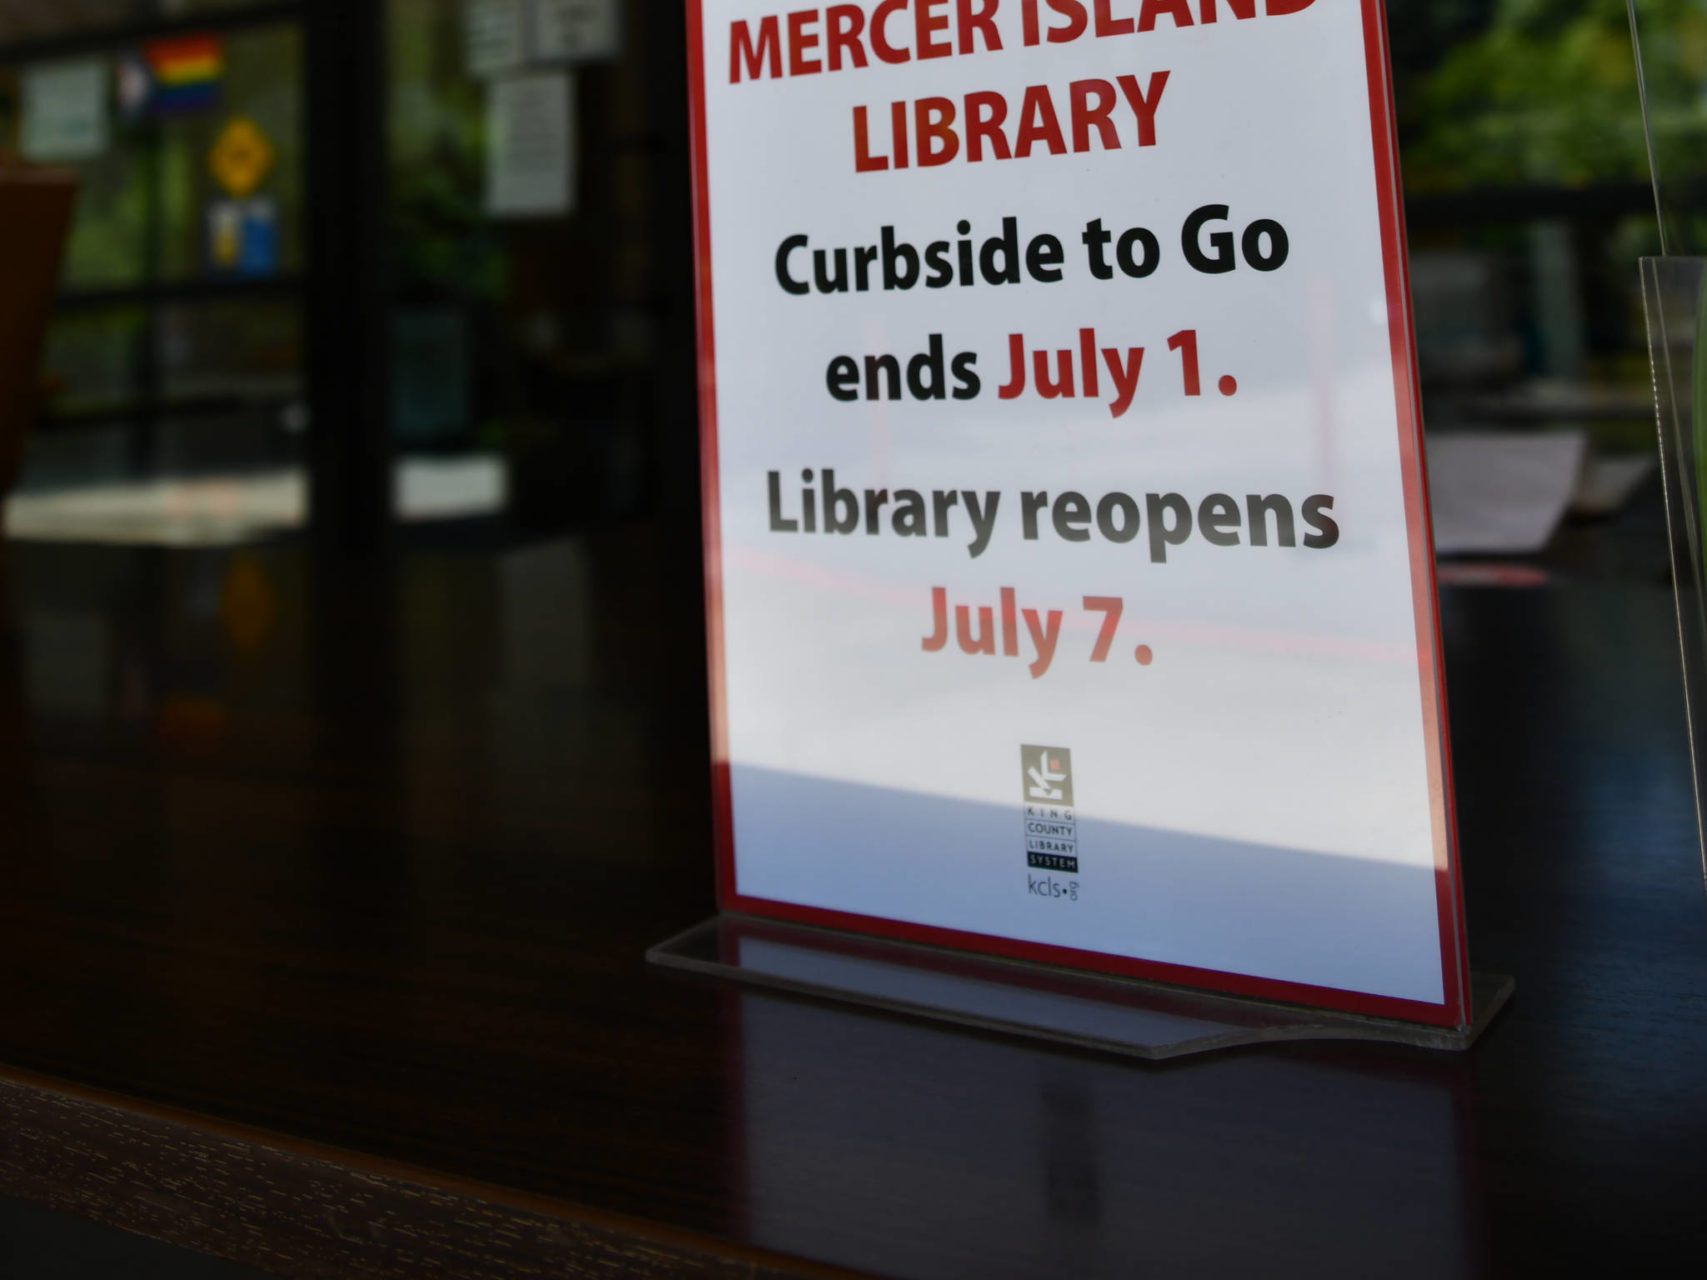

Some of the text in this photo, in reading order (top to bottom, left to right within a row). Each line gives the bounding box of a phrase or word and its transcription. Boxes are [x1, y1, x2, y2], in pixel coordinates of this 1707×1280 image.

[853, 70, 1170, 172] LIBRARY
[775, 204, 1289, 295] Curbside to Go
[825, 327, 1238, 419] ends July 1.
[766, 469, 1340, 562] Library reopens
[921, 586, 1153, 679] July 7.
[1028, 823, 1073, 836] COUNTY
[1029, 840, 1074, 853] LIBRARY
[1030, 855, 1076, 869] SYSTEM
